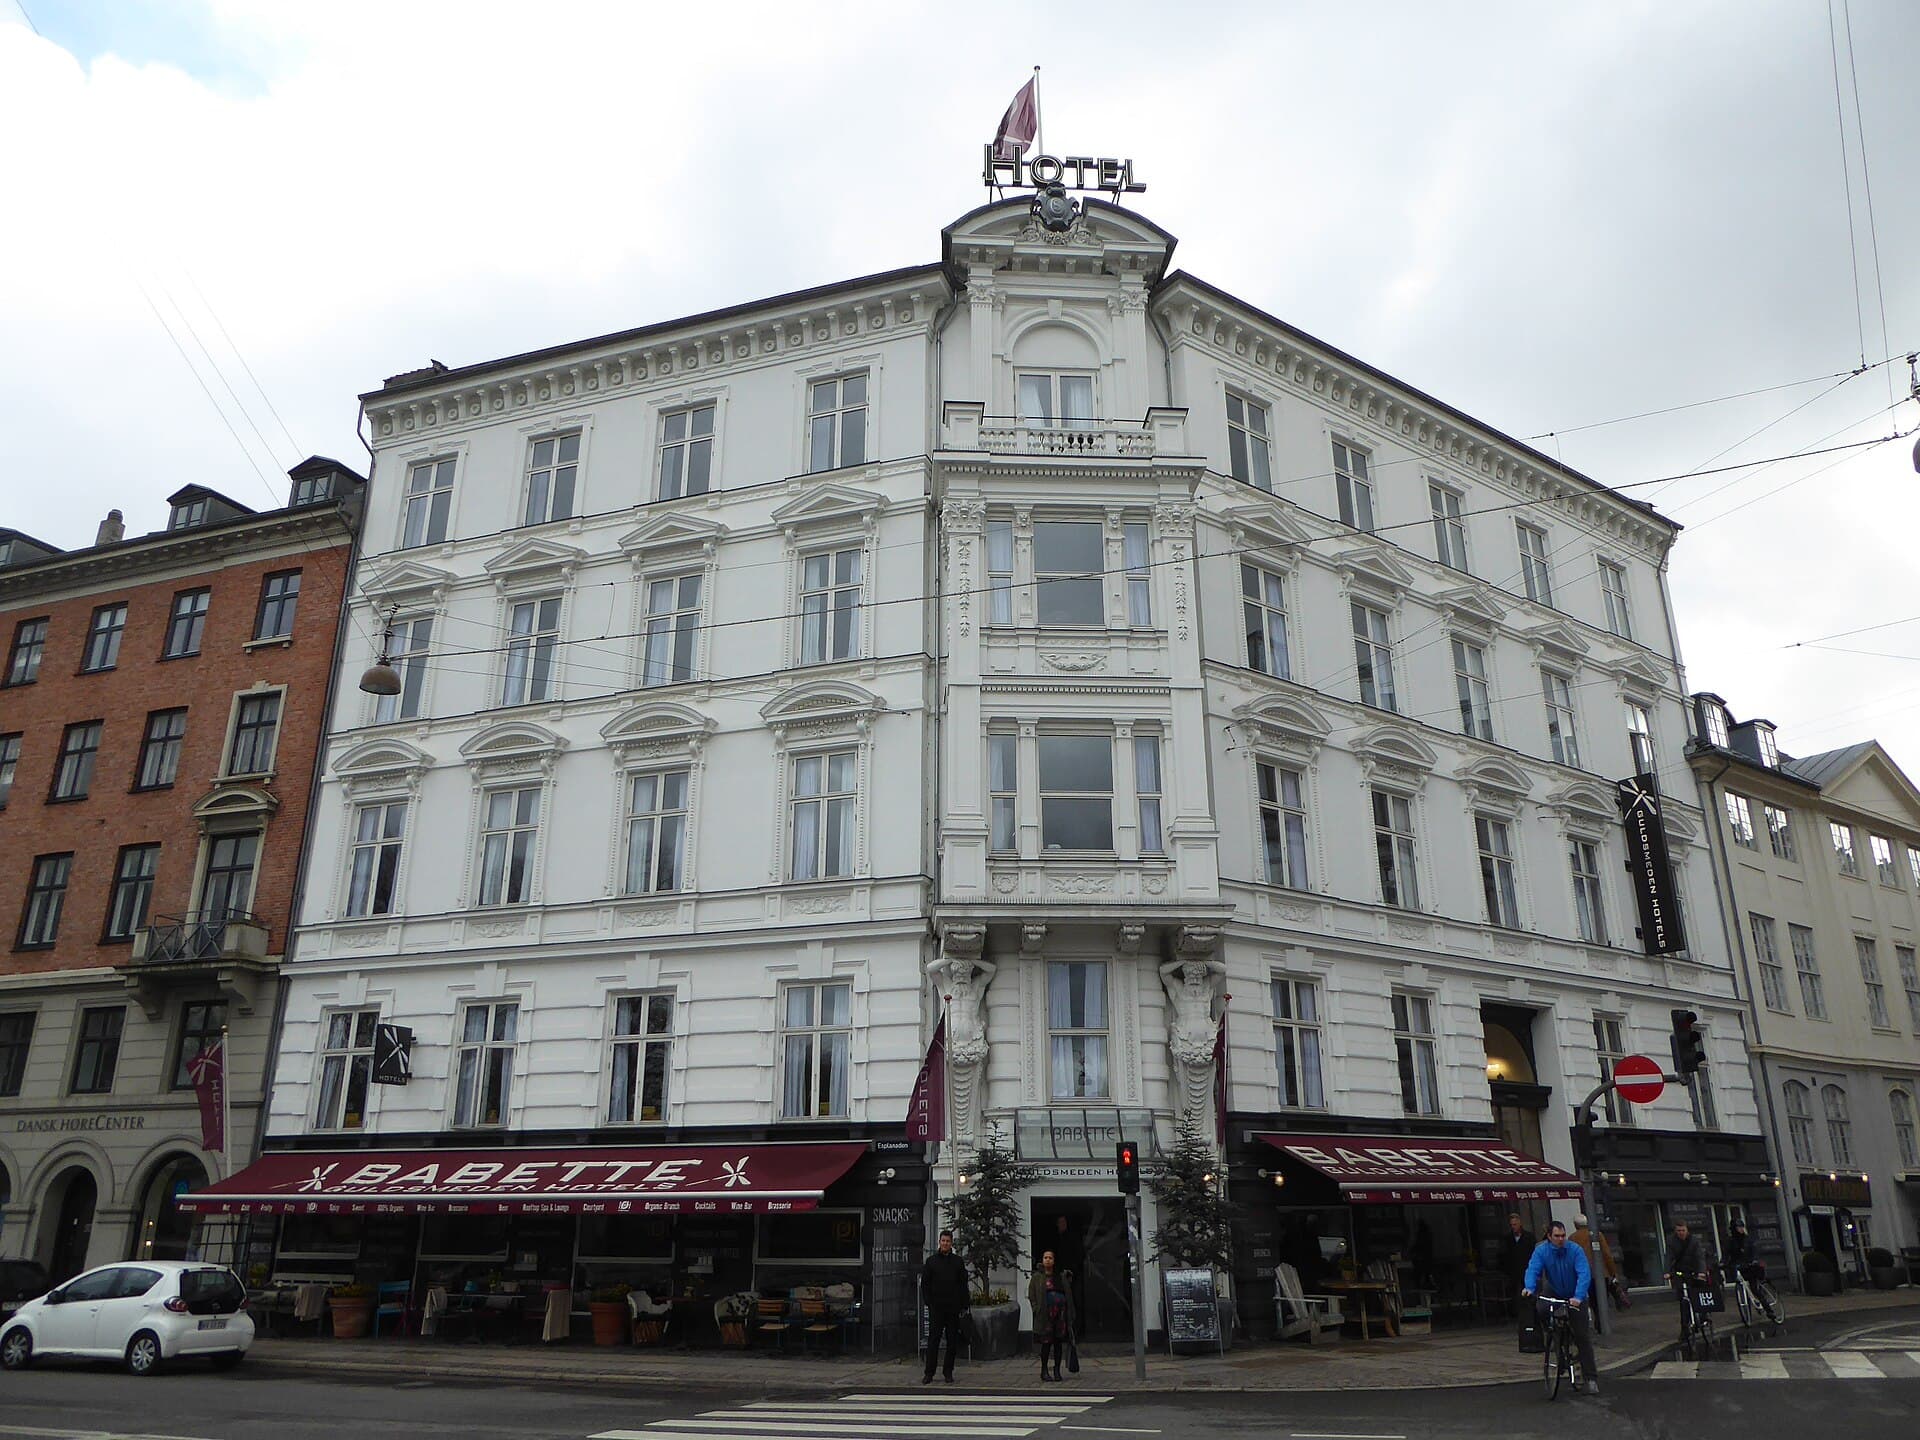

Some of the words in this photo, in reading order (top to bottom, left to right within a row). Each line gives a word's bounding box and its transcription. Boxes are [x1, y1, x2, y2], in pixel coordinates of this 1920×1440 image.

[984, 143, 1146, 192] HOTEL
[1636, 810, 1657, 894] GULDSMEDEN
[1652, 898, 1666, 949] HOTELS
[16, 1118, 57, 1133] DANSK
[1053, 1126, 1116, 1142] BABETTE
[1284, 1145, 1540, 1166] BABETTE
[341, 1159, 703, 1185] BABETTE
[1320, 1166, 1477, 1176] GULDSMEDEN
[1480, 1166, 1560, 1175] HOTELS
[322, 1184, 537, 1193] GULDSMEDEN
[544, 1183, 677, 1191] HOTELS
[873, 1207, 909, 1223] SNACKS
